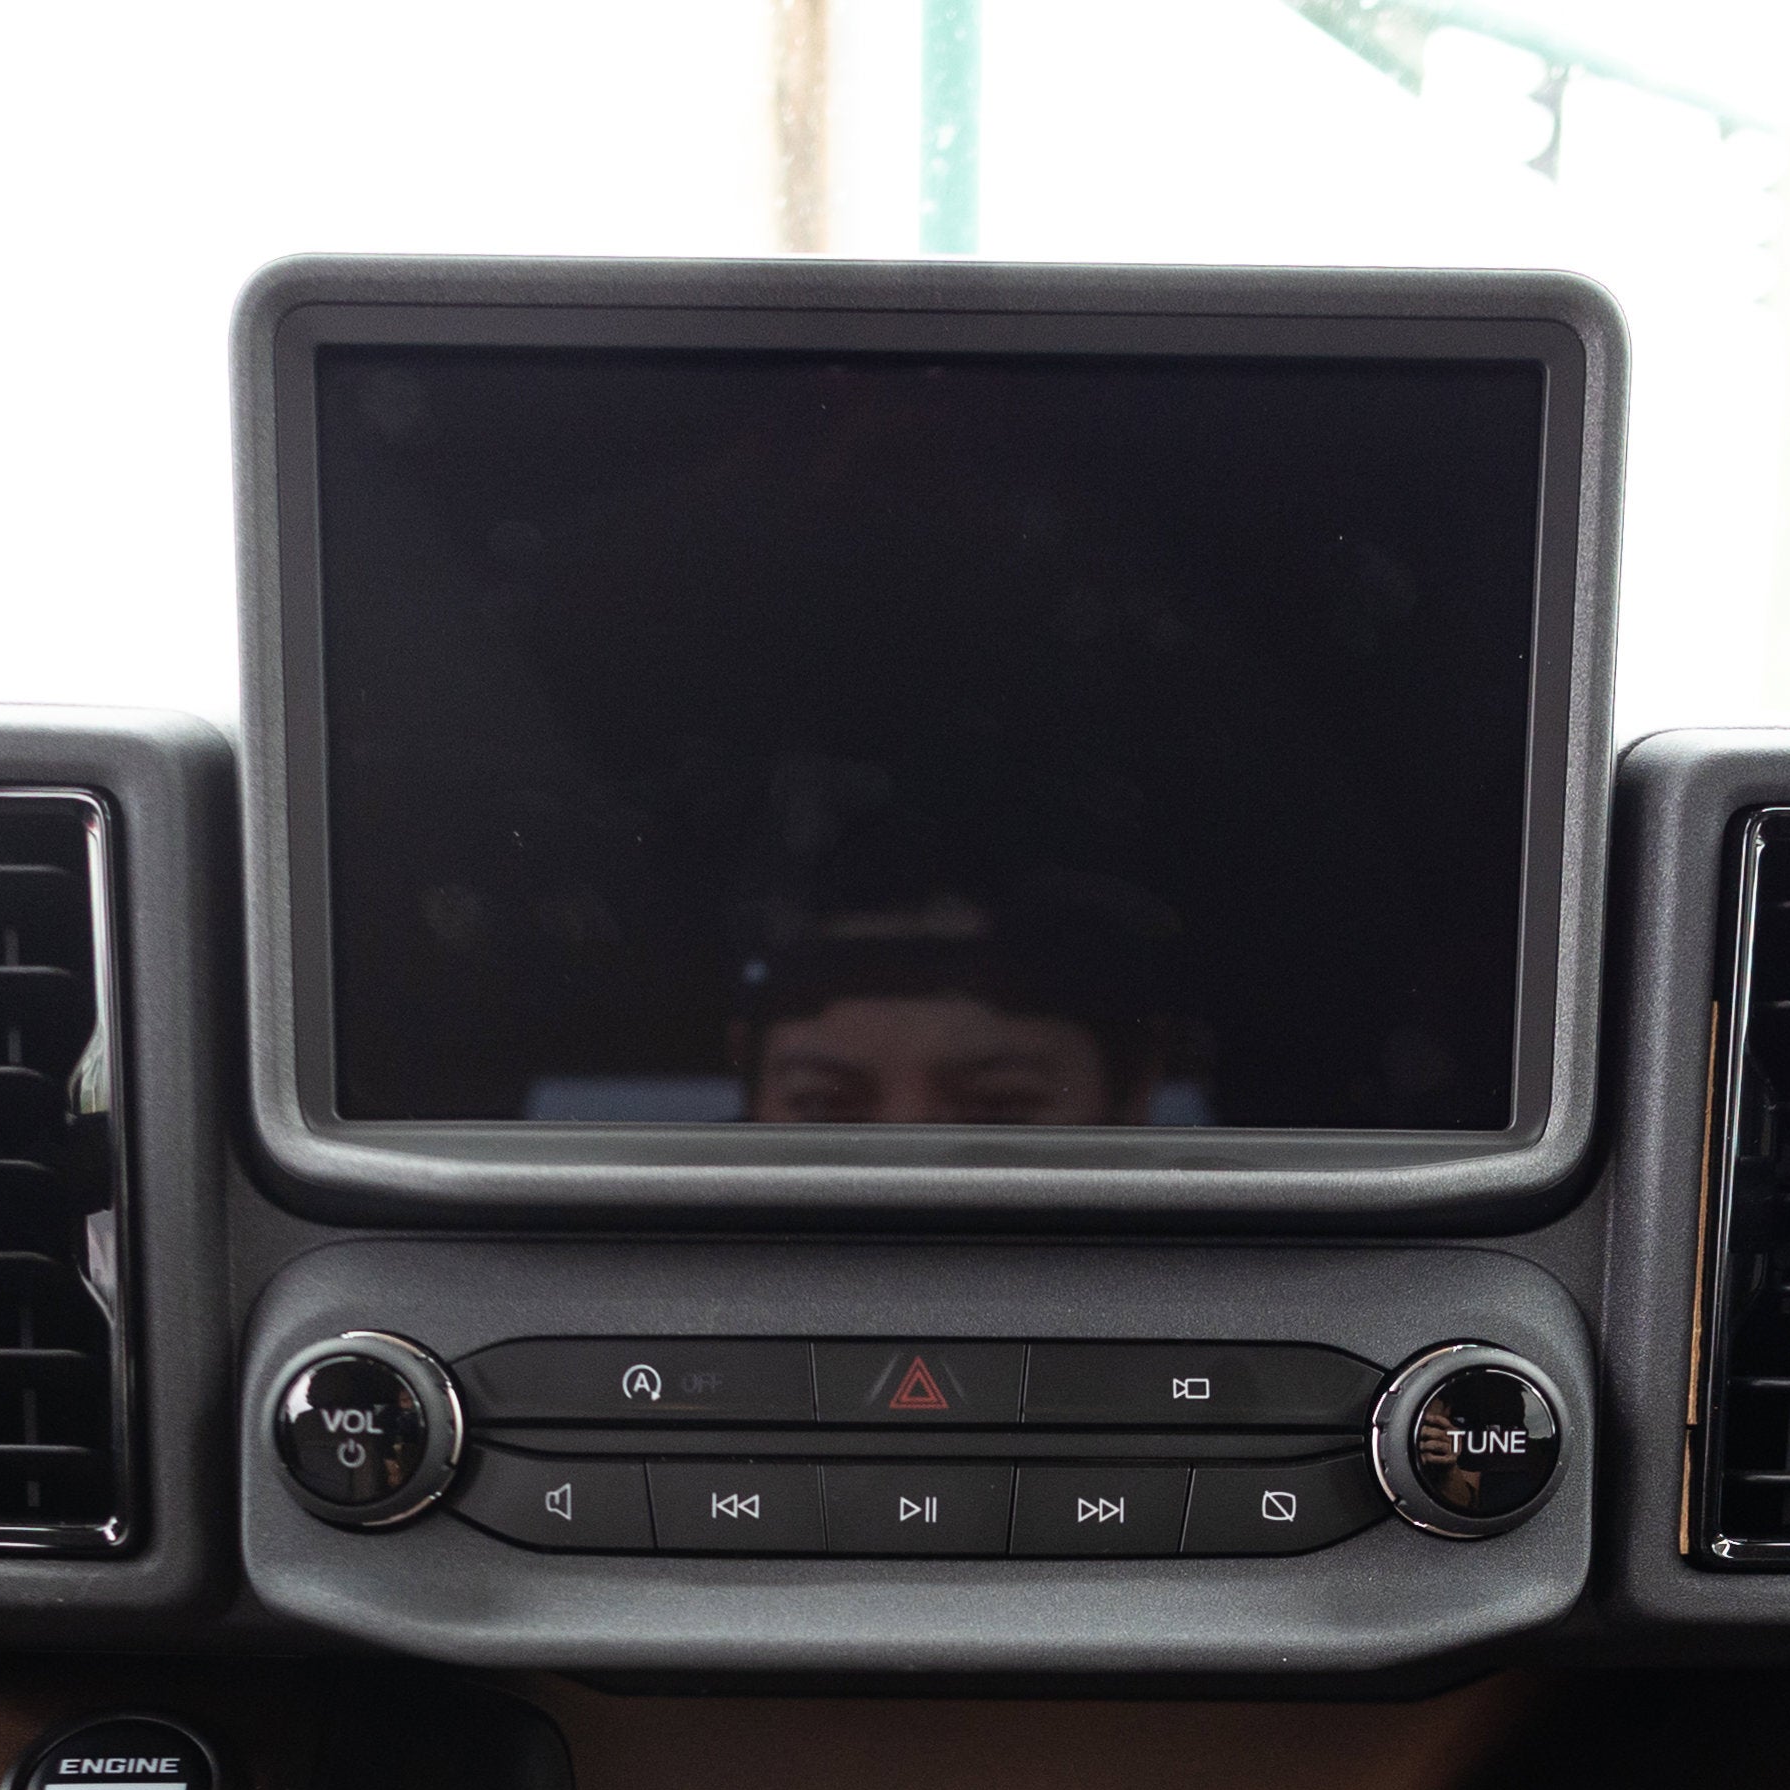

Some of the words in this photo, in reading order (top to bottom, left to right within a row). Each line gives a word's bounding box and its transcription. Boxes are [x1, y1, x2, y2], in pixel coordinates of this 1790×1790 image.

[322, 1409, 383, 1435] VOL
[1447, 1430, 1527, 1455] TUNE
[58, 1757, 181, 1775] ENGINE
